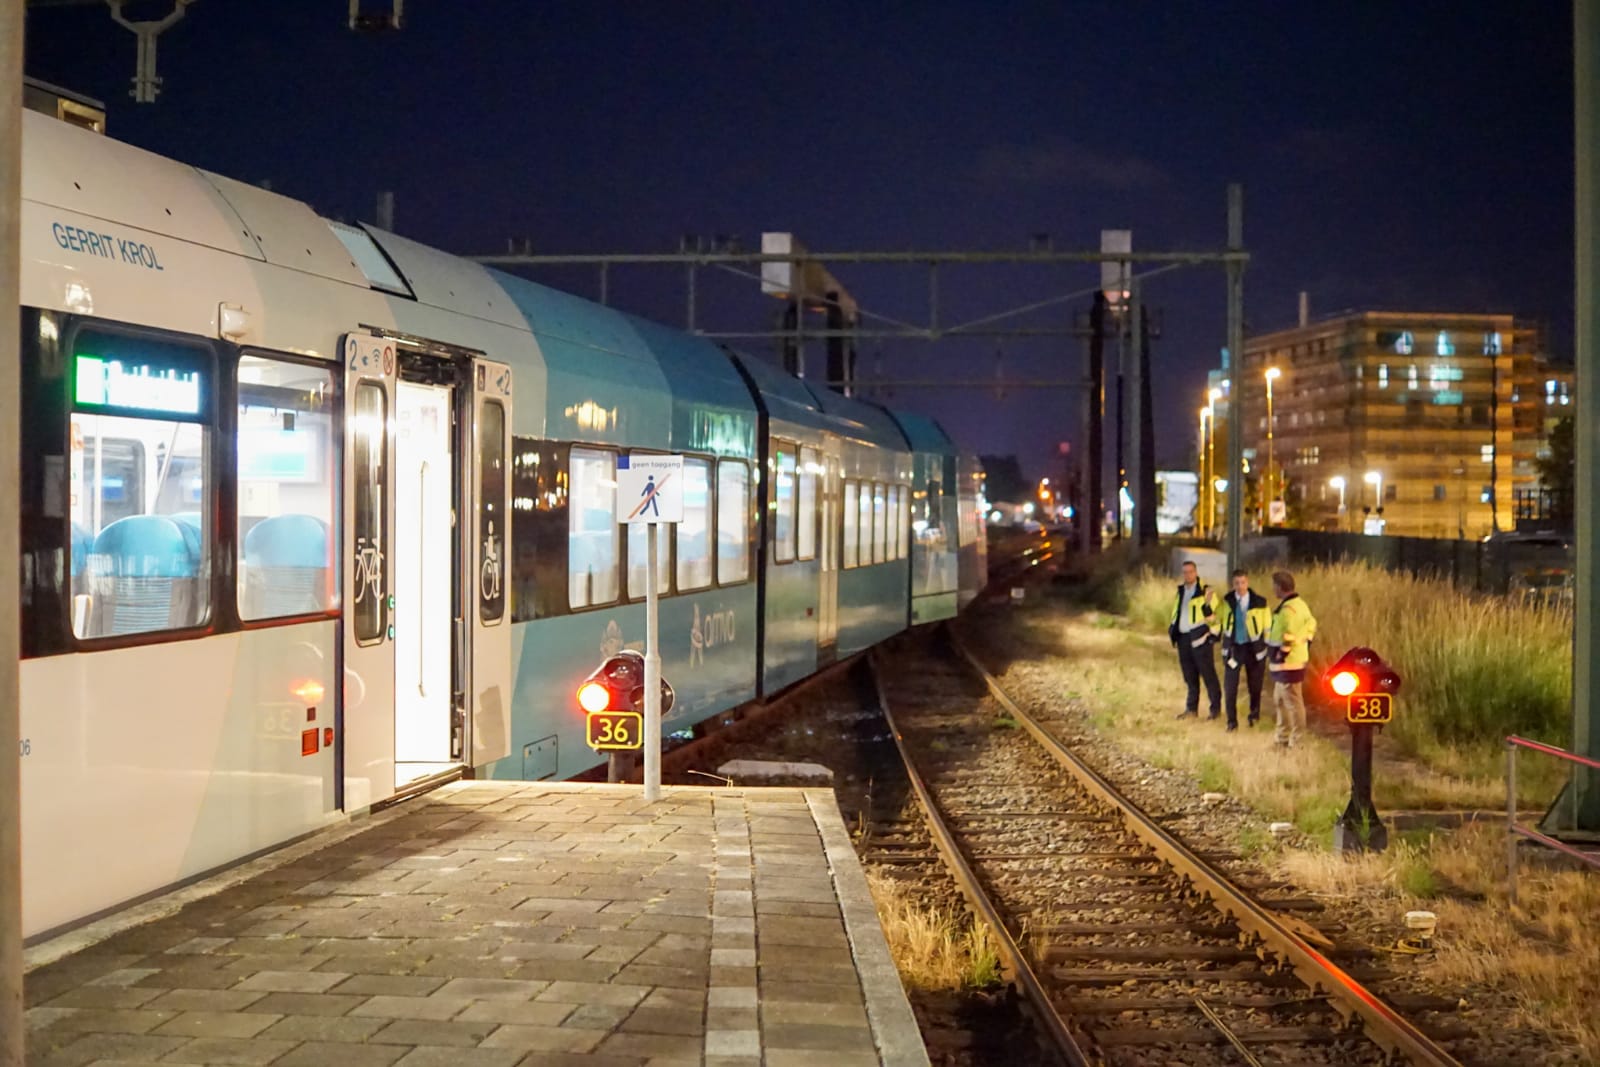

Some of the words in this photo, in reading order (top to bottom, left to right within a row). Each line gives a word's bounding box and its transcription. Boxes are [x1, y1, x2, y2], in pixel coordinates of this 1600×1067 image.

[52, 222, 115, 260] GERRIT
[116, 238, 164, 271] KROL
[349, 339, 357, 371] 2
[504, 369, 511, 395] 2
[631, 461, 650, 469] geen
[650, 461, 681, 469] toegang
[1356, 697, 1381, 717] 38
[598, 717, 628, 742] 36
